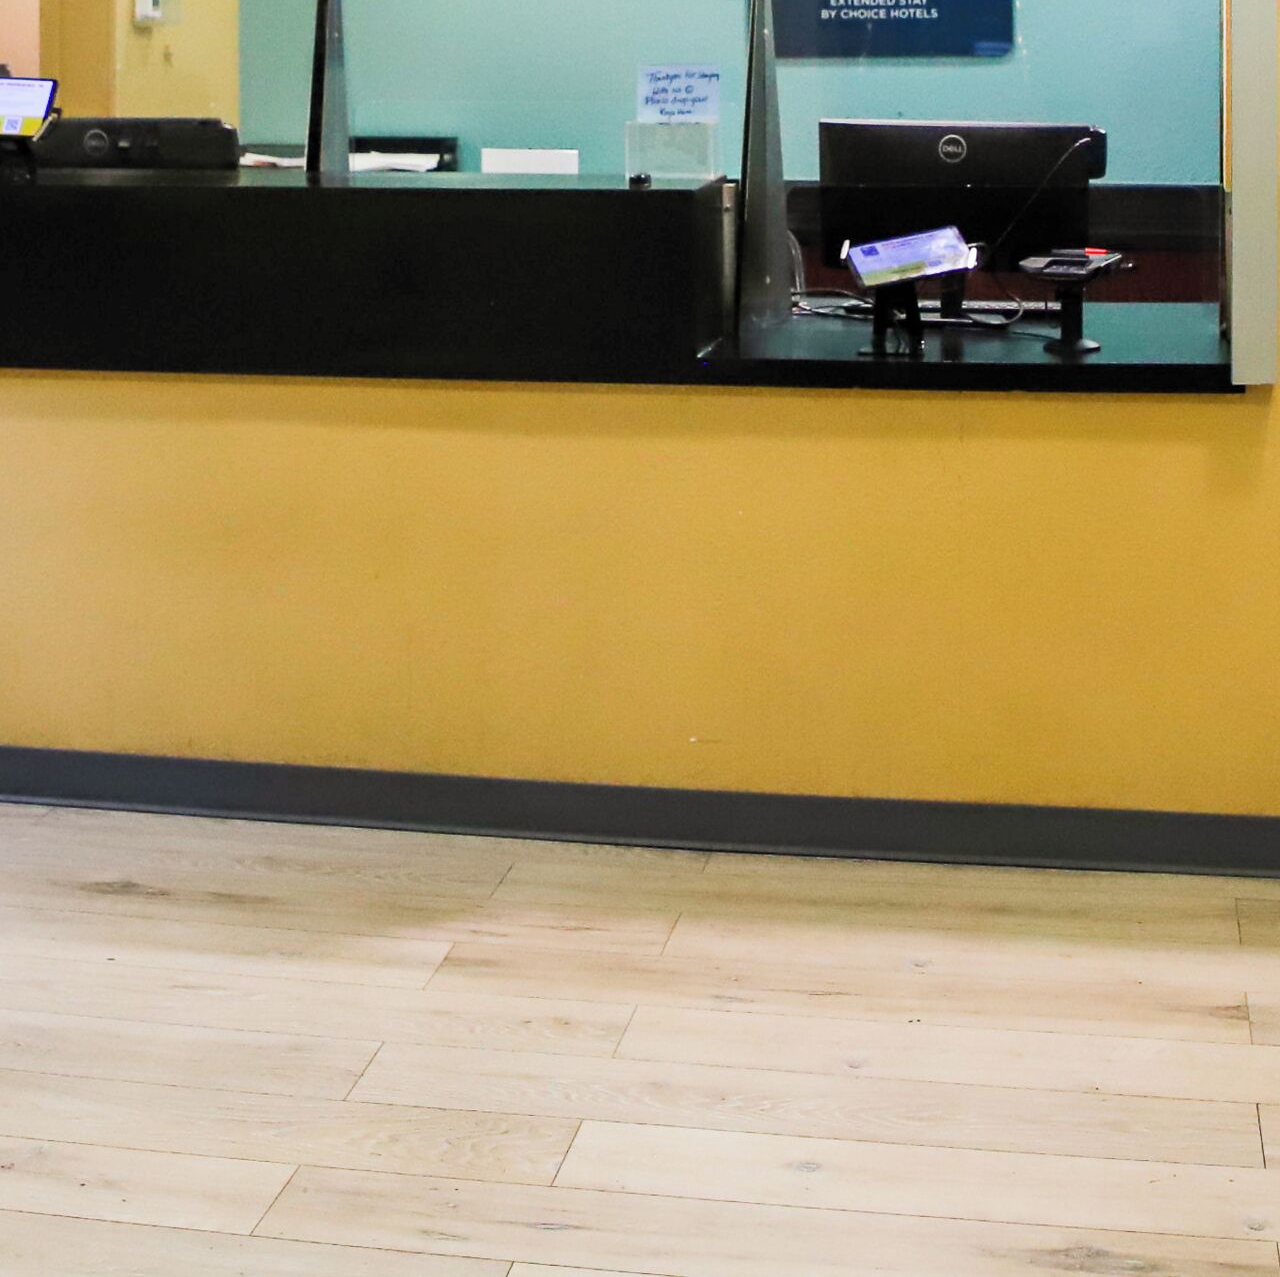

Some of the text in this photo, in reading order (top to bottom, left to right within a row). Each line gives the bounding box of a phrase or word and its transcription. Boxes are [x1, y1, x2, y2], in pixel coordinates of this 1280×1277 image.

[821, 9, 939, 19] BY CHOICE HOTELS
[942, 145, 962, 153] DELL
